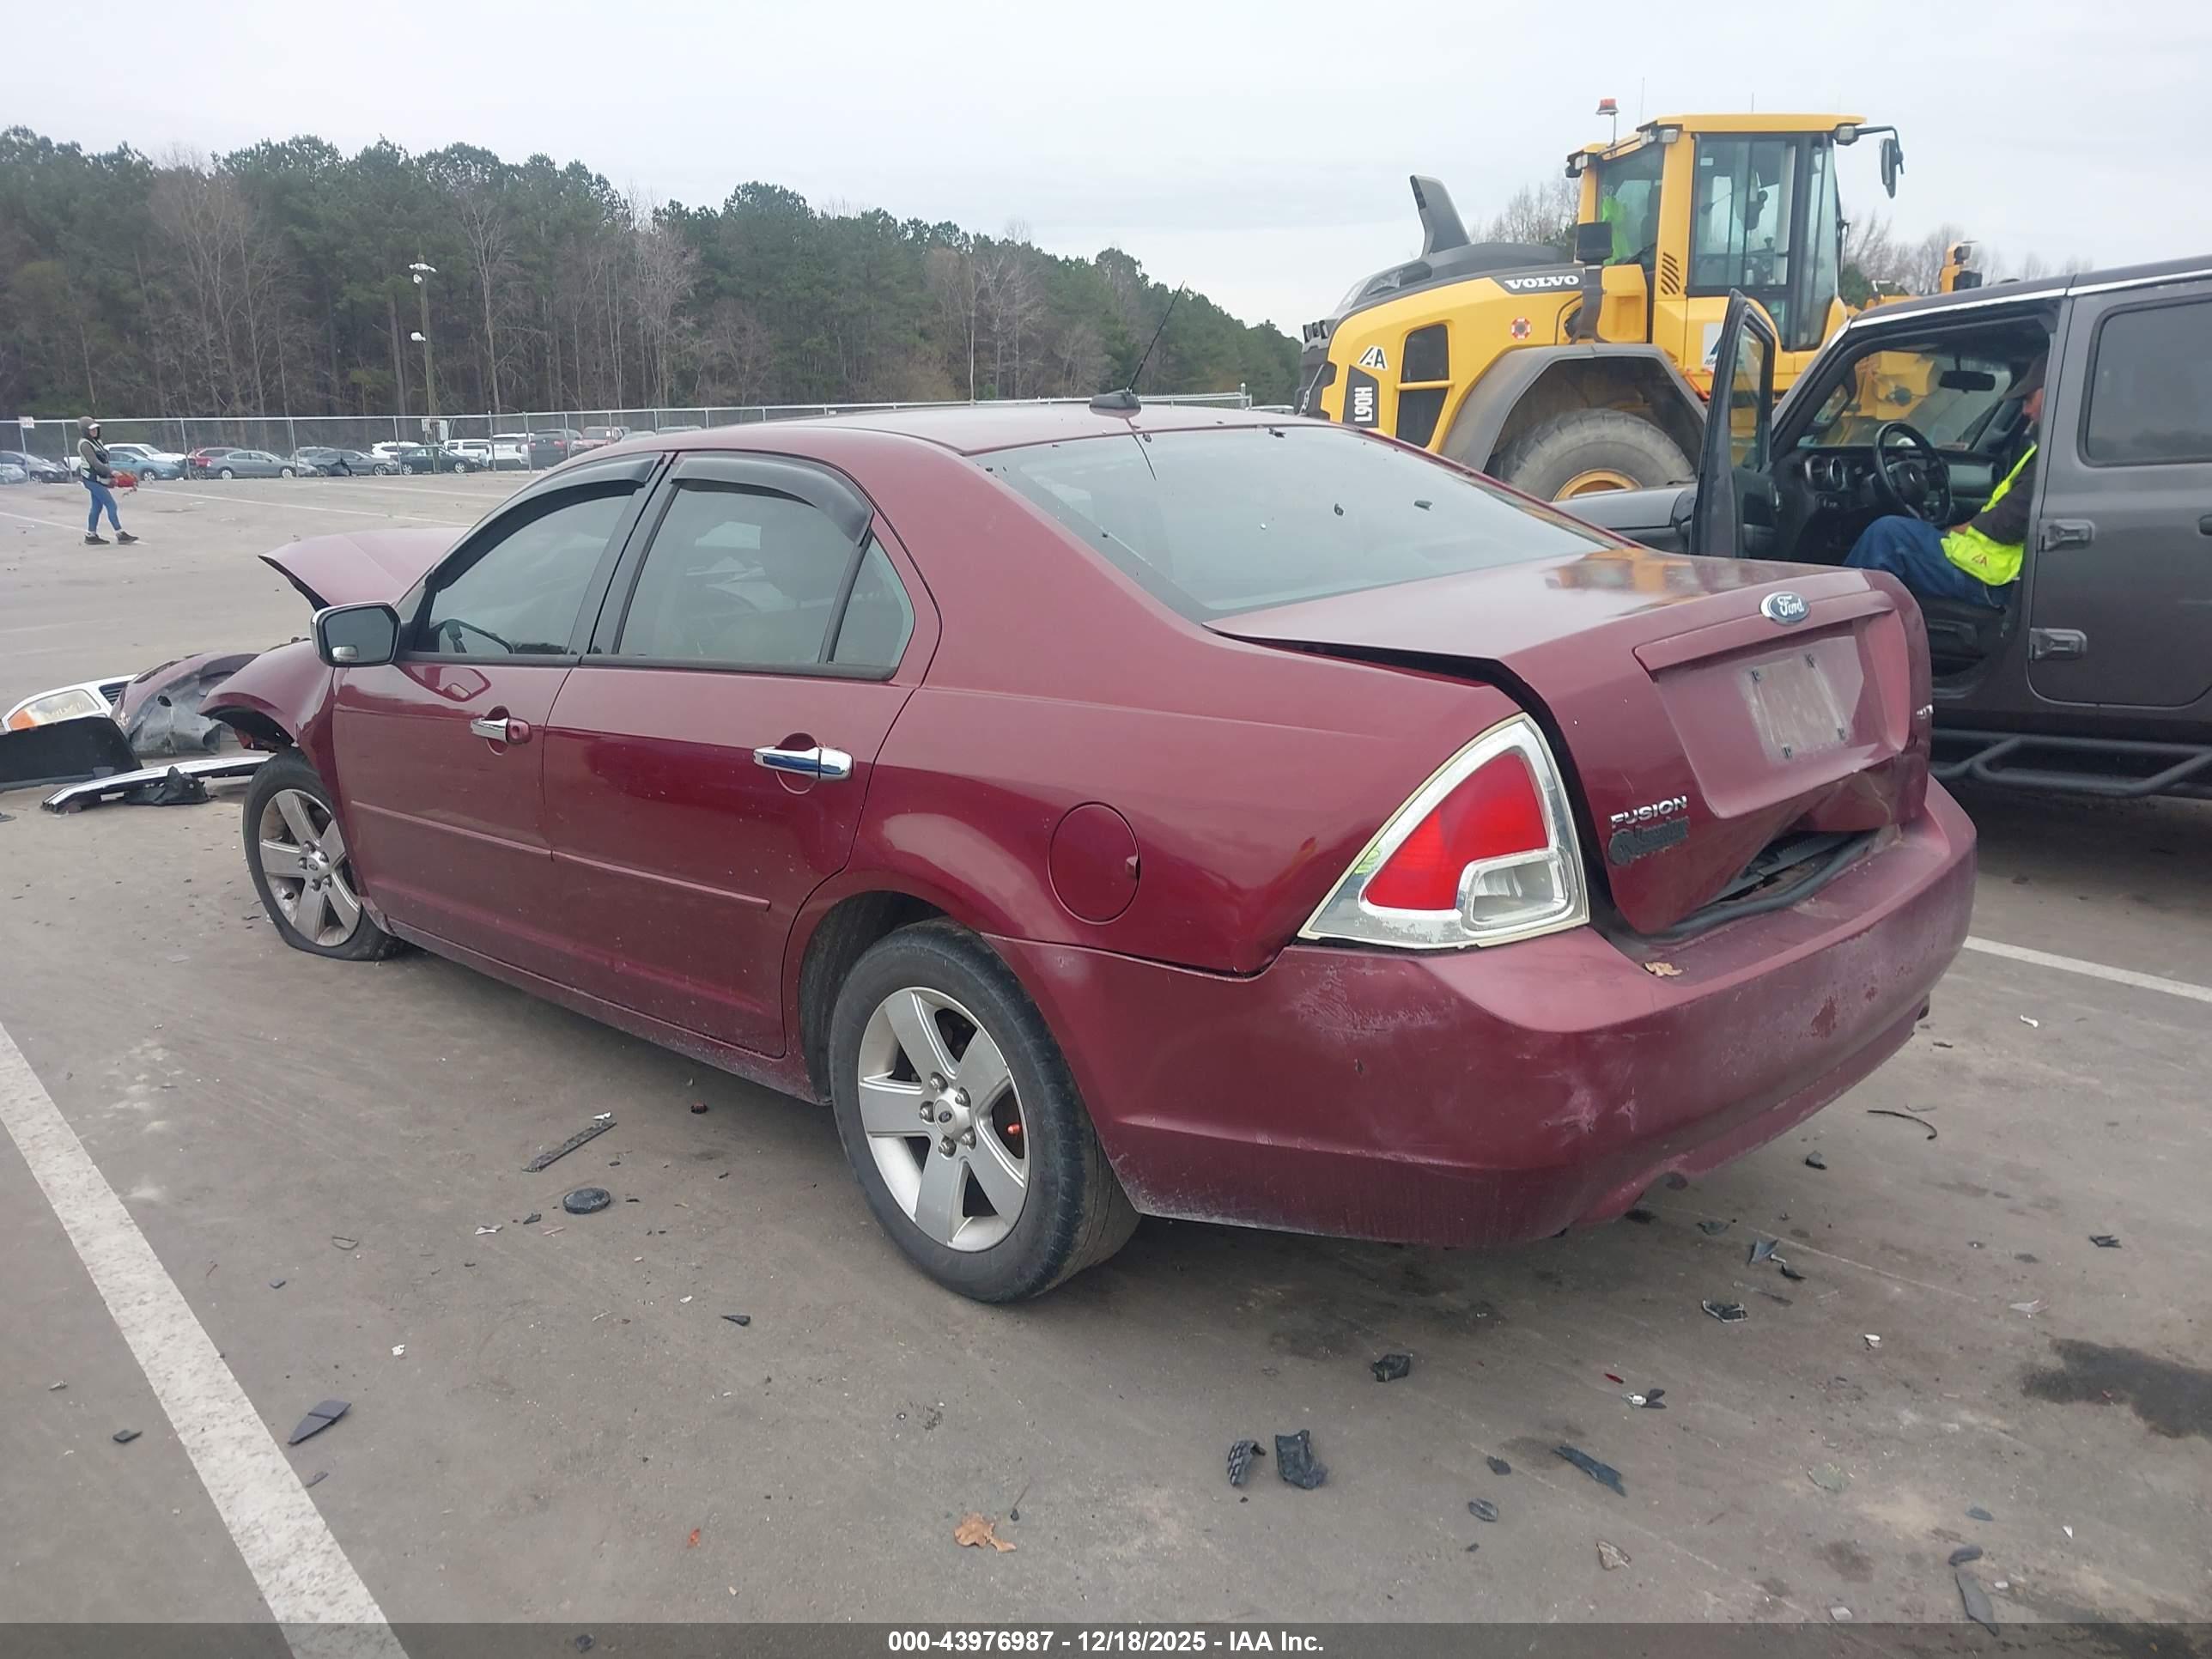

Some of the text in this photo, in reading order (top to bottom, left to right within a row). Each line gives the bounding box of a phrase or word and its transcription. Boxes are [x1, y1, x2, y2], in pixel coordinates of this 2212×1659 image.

[1504, 275, 1579, 289] VOLVO
[1353, 386, 1373, 422] L90H
[1777, 594, 1805, 617] Ford
[1610, 795, 1687, 830] FUSION
